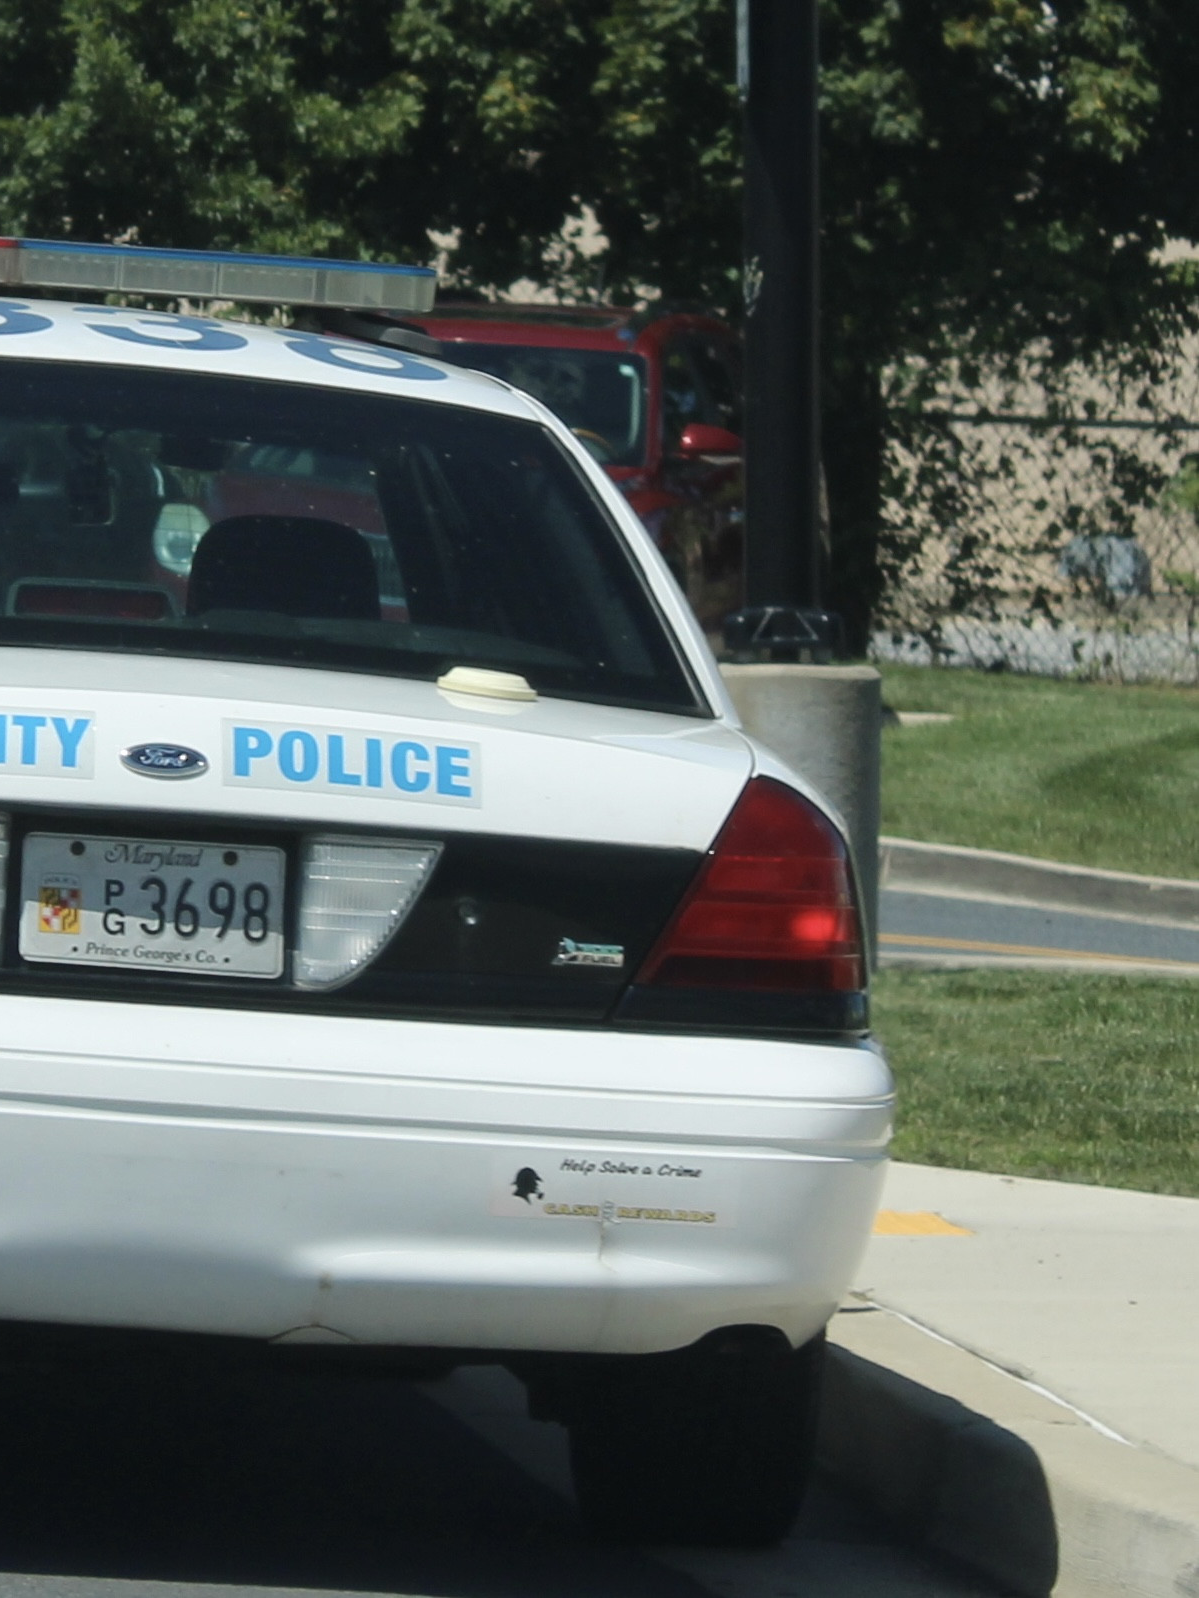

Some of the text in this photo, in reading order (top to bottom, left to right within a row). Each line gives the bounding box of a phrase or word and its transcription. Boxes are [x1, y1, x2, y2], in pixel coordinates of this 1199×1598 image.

[139, 747, 188, 768] Ford
[232, 726, 472, 798] POLICE
[105, 843, 204, 871] Maryland
[140, 875, 270, 943] 3698
[86, 942, 218, 964] Prince George's Co.
[560, 1158, 702, 1178] Help Solve a Crime
[544, 1203, 716, 1223] CASH REWARDS
